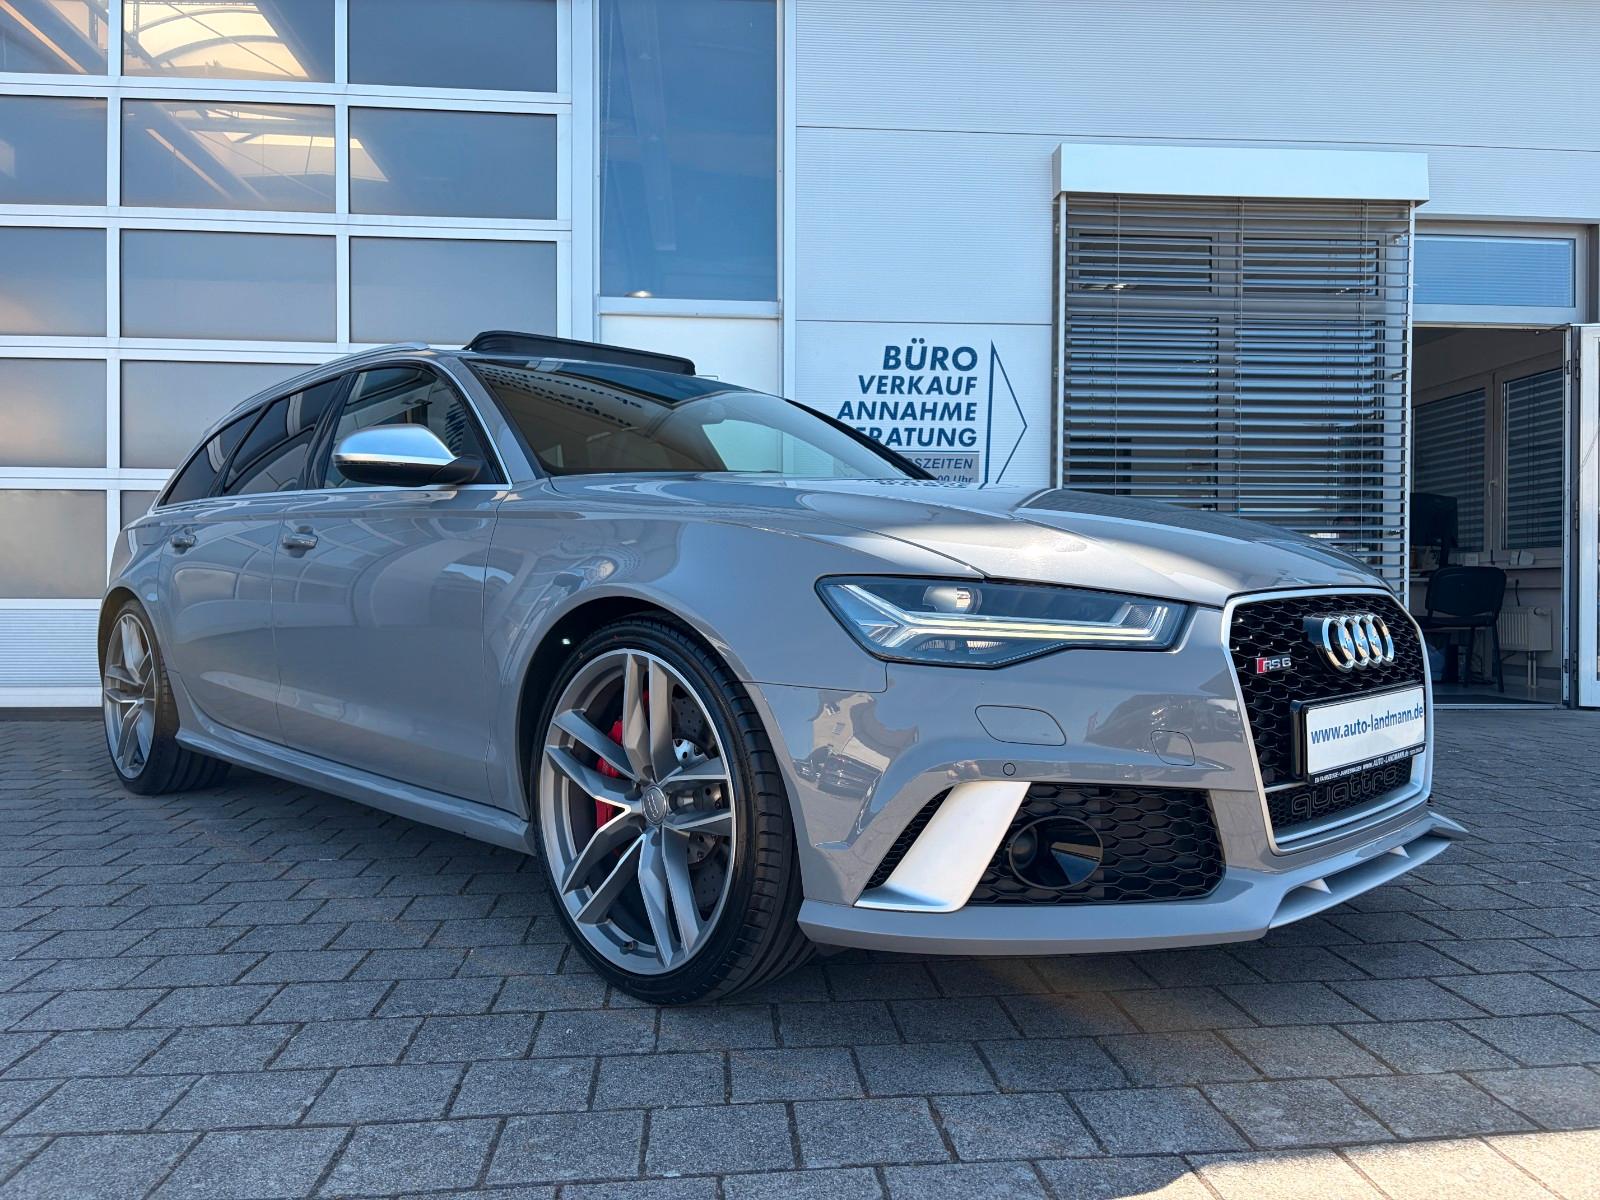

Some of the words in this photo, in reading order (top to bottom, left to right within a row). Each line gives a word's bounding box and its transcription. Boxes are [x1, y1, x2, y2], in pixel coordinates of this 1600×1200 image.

[883, 338, 978, 371] BÜRO
[858, 375, 978, 395] VERKAUF
[837, 401, 977, 421] ANNAHME
[1311, 703, 1424, 744] www.auto-landmann.de
[1291, 767, 1397, 818] quattro
